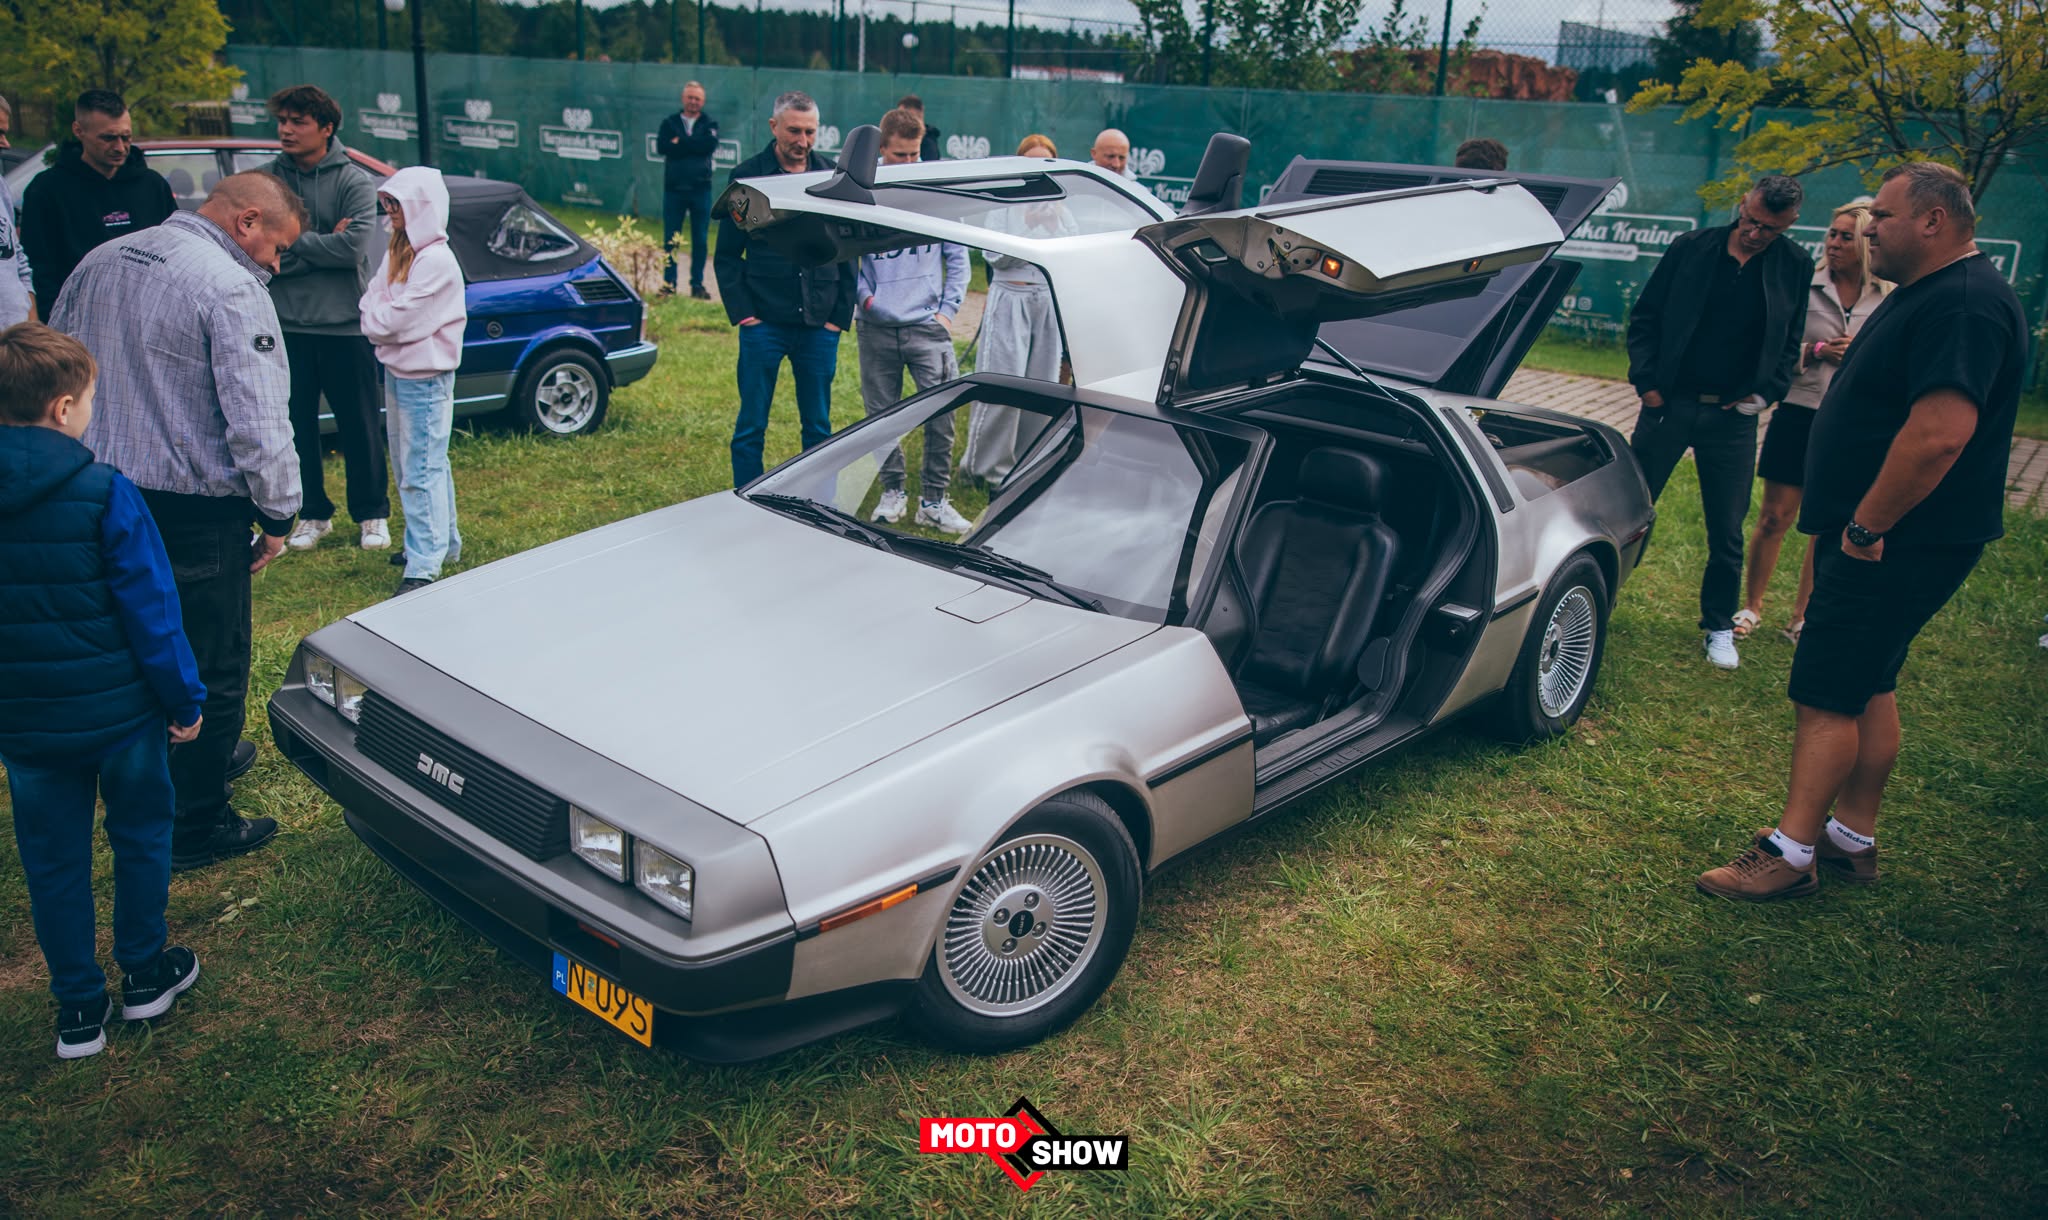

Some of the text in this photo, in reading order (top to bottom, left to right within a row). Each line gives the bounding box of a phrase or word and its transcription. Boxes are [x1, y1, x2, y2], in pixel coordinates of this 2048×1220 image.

[119, 245, 167, 264] FASHION
[1836, 826, 1873, 846] adidas
[555, 970, 566, 985] PL
